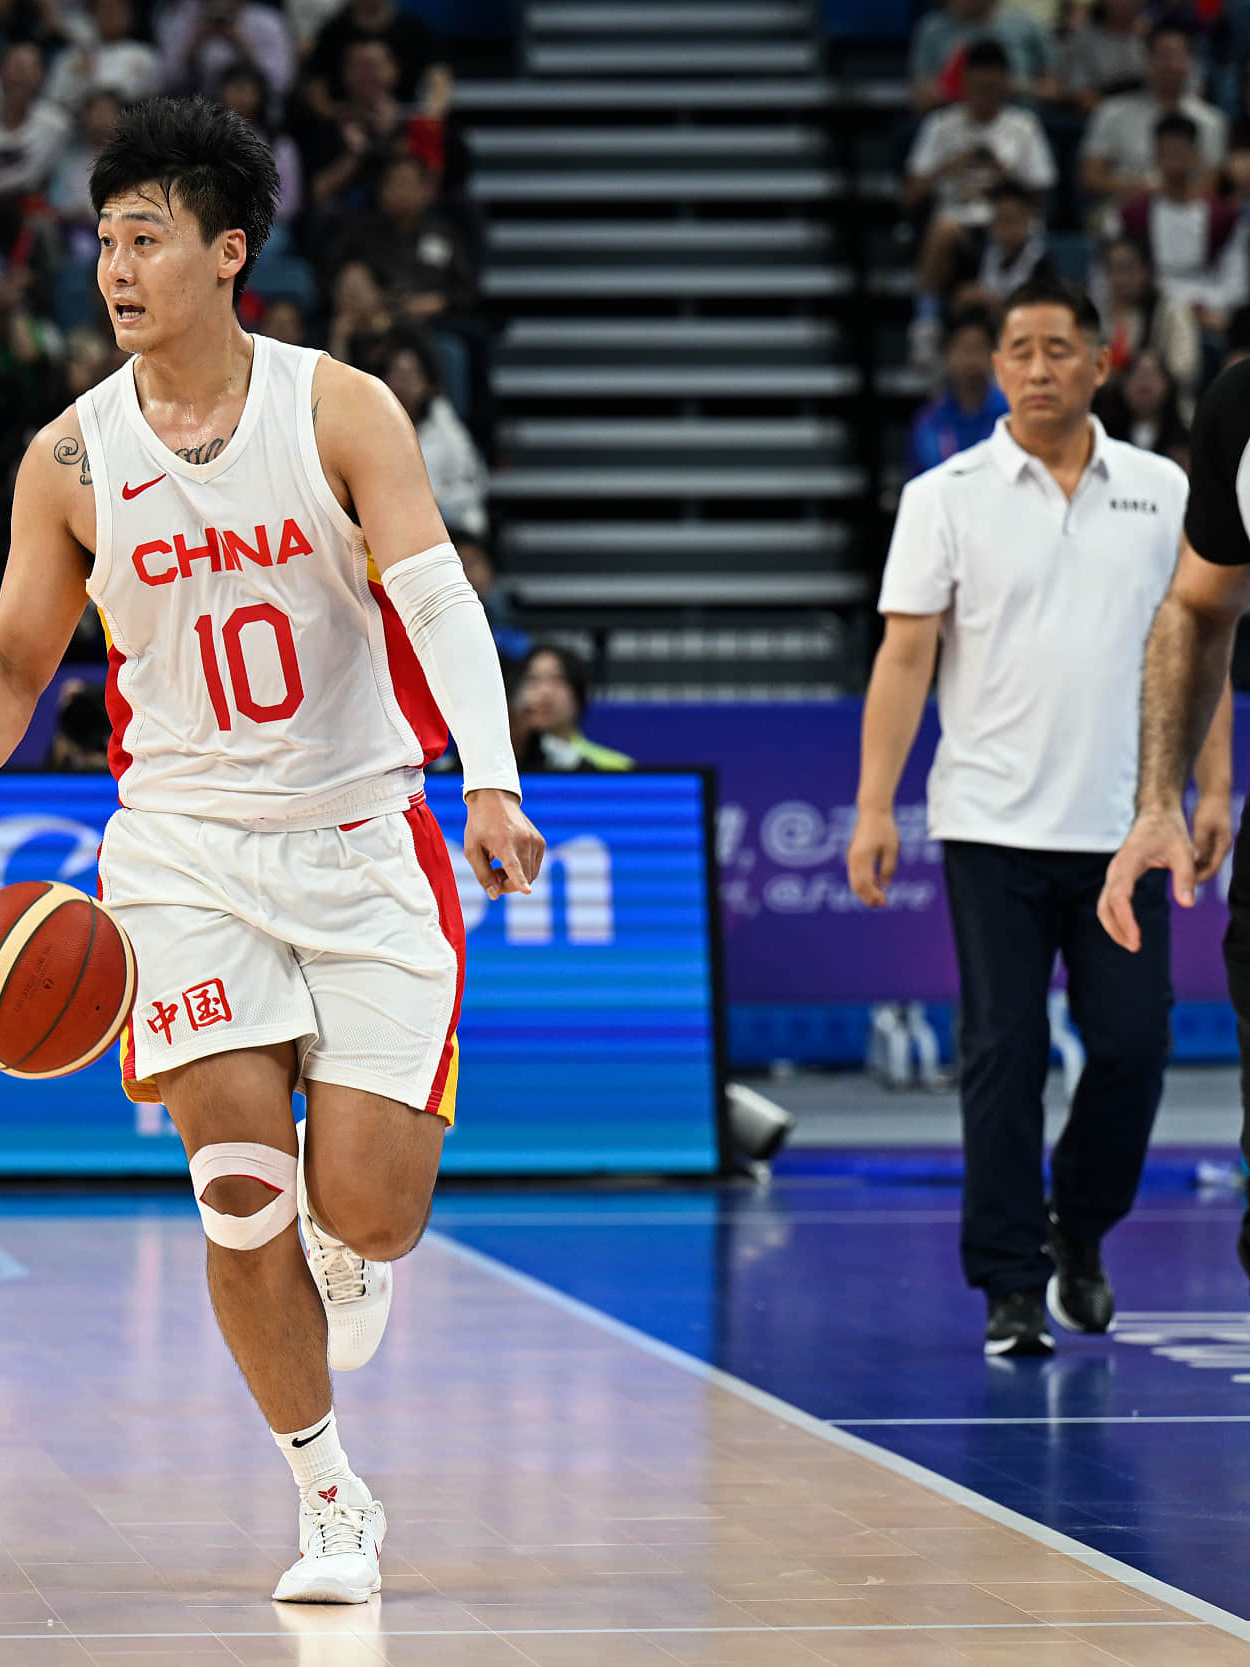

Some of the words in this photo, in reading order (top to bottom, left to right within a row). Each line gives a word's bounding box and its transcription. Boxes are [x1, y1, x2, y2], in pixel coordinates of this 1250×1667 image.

[131, 518, 314, 587] CHINA
[194, 602, 305, 731] 10
[147, 978, 233, 1045] 中国
